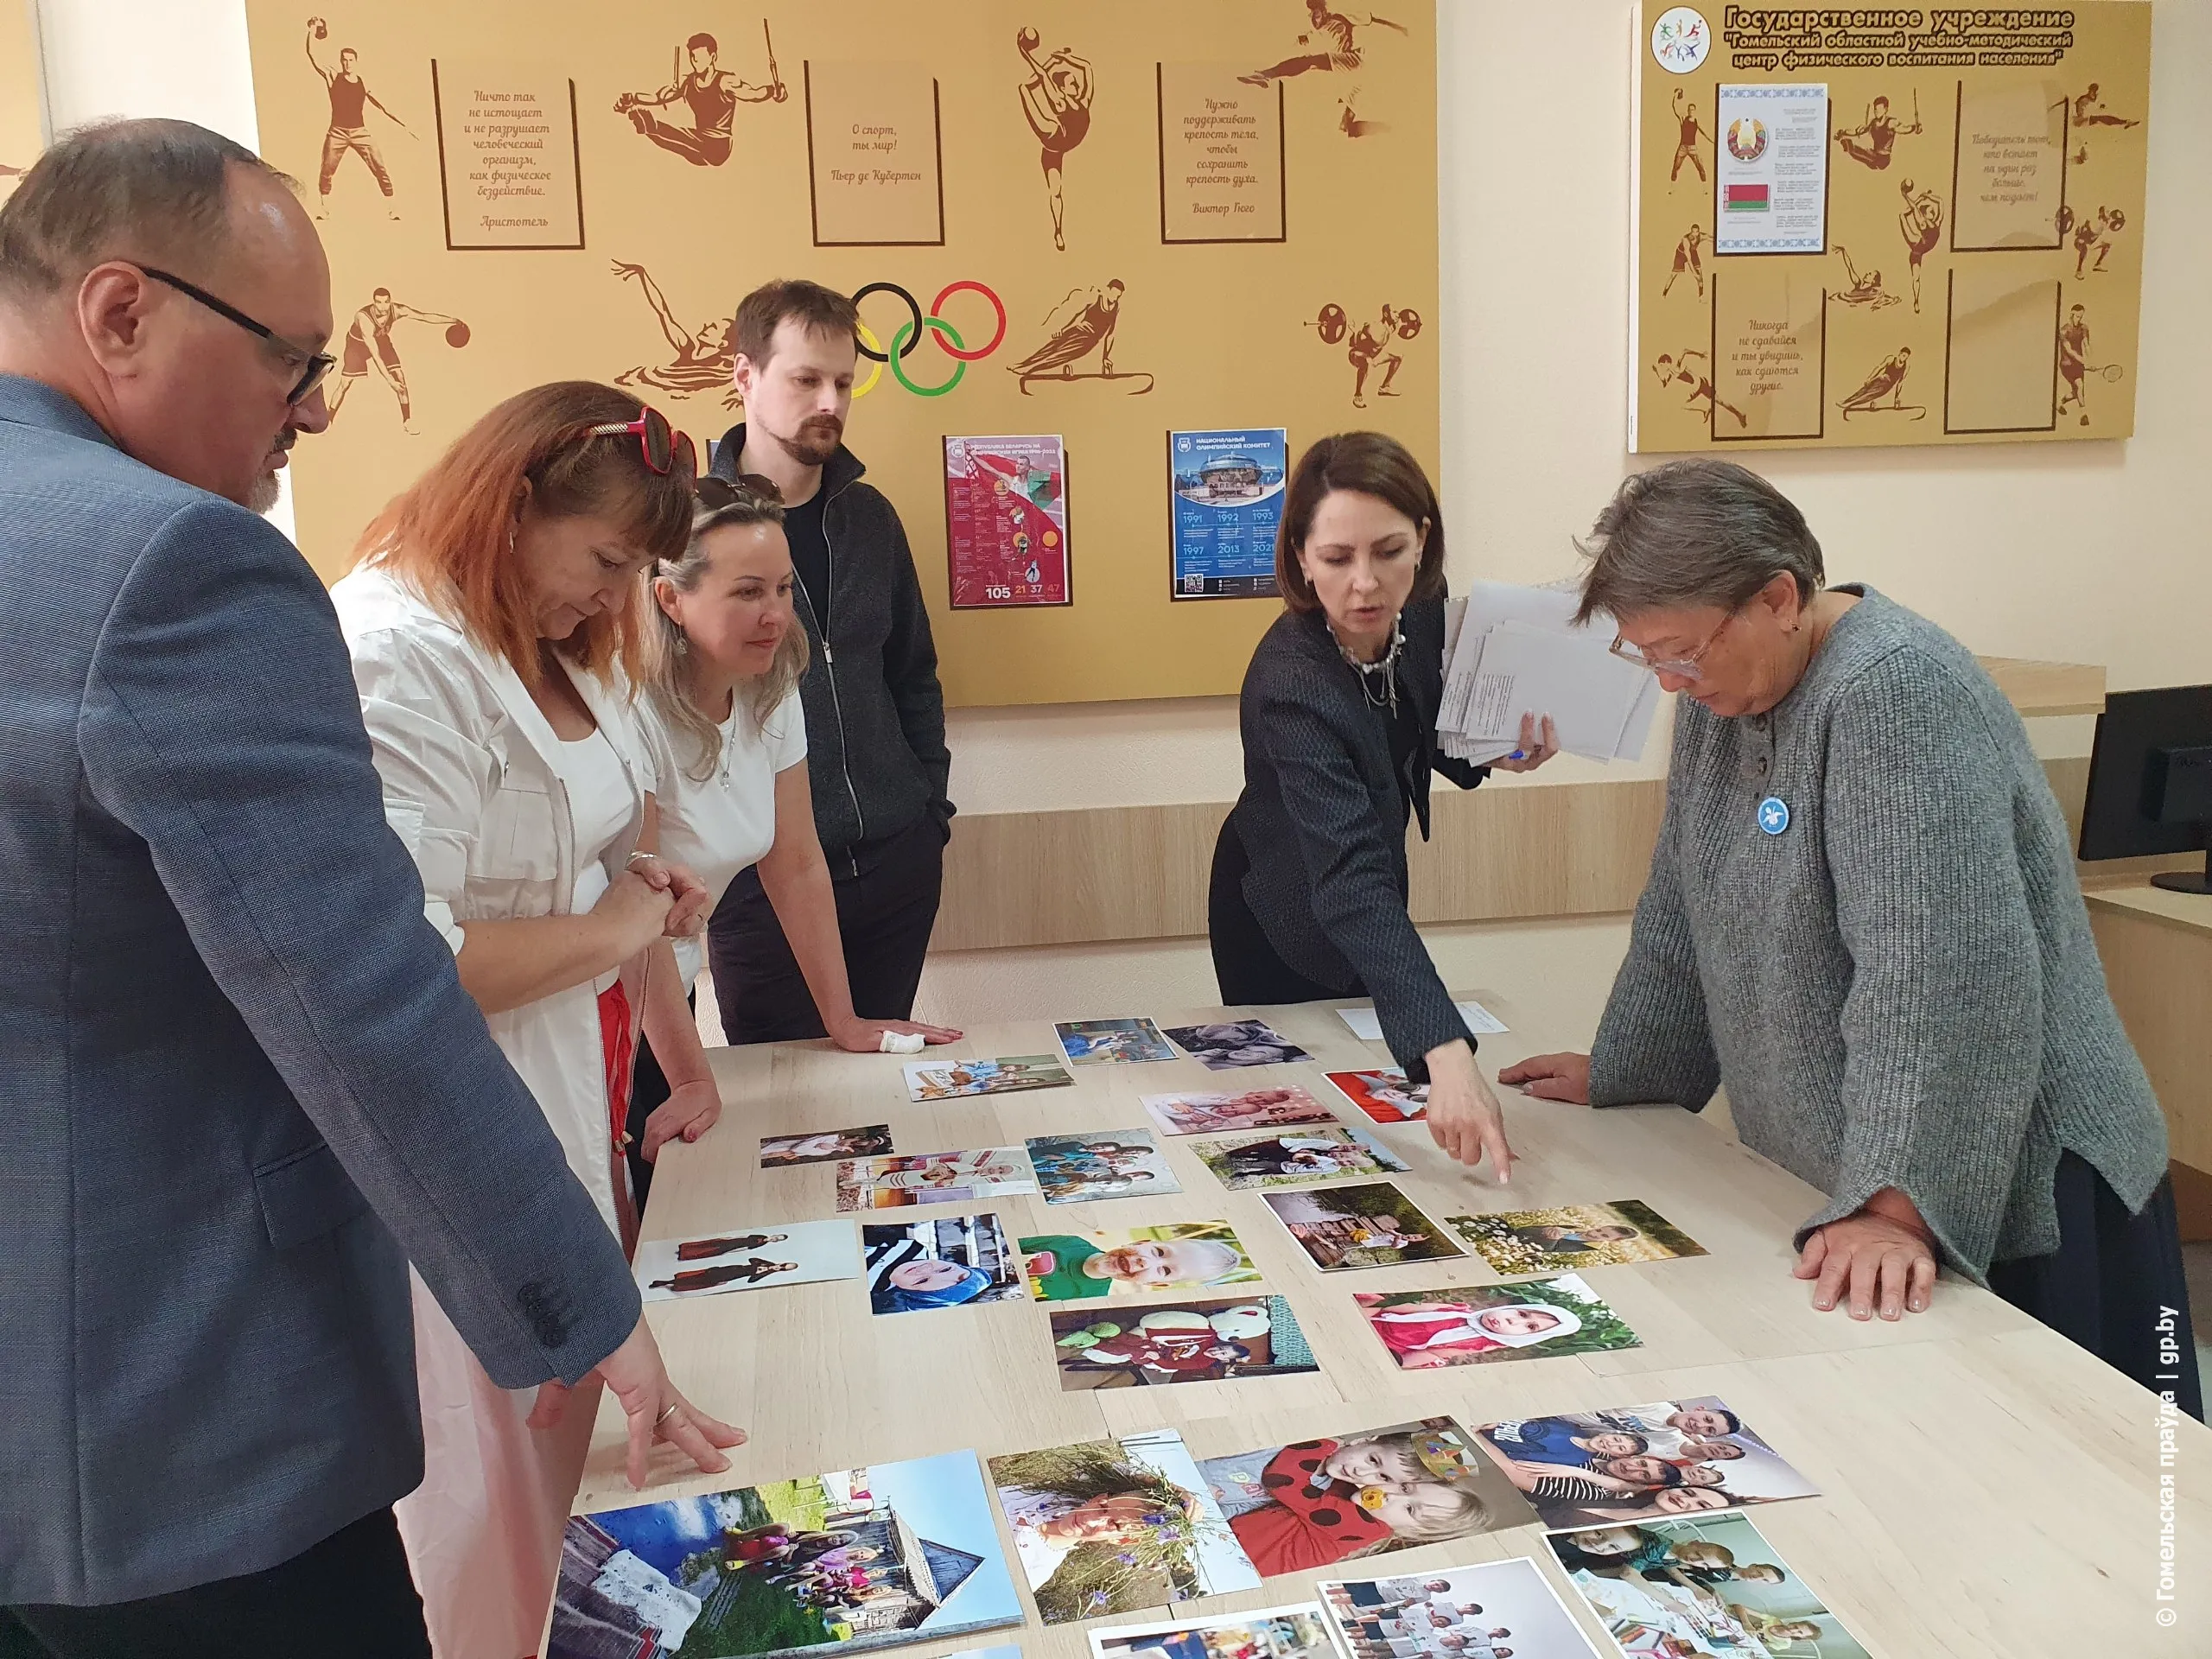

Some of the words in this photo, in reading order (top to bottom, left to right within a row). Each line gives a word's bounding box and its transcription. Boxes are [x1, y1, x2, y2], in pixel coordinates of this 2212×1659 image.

[1726, 5, 1923, 33] Государственное
[1930, 10, 2075, 33] учреждение
[1724, 31, 1822, 49] "Гомельский
[1825, 30, 1905, 48] областной
[1909, 30, 2073, 51] учебно-методический
[1732, 53, 1779, 70] центр
[1782, 50, 1885, 71] физического
[1887, 51, 1975, 67] воспитания
[1979, 48, 2064, 66] населения"
[474, 90, 511, 103] Ничто
[513, 92, 536, 102] так
[1205, 98, 1238, 113] Нужно
[469, 109, 480, 118] не
[484, 109, 543, 119] истощает
[1184, 114, 1255, 129] поддерживать
[488, 124, 550, 137] разрушает
[852, 124, 860, 135] О
[862, 126, 897, 139] спорт,
[474, 139, 543, 149] человеческий
[1184, 132, 1228, 143] крепость
[852, 142, 869, 150] ты
[872, 139, 898, 155] мир!
[1206, 144, 1237, 154] чтобы
[483, 156, 537, 168] организм,
[1197, 160, 1248, 173] сохранить
[491, 171, 551, 184] физическое
[831, 169, 855, 185] Пьер
[858, 173, 869, 185] де
[872, 169, 921, 185] Кубертен
[1186, 175, 1230, 188] крепость
[477, 185, 546, 200] бездействие.
[1192, 203, 1230, 217] Виктор
[1234, 202, 1255, 213] Гюго
[480, 216, 549, 231] Аристотель
[1749, 320, 1789, 334] Никогда
[1752, 335, 1796, 350] сдавайся
[1755, 366, 1799, 380] сдаются
[1196, 435, 1246, 444] НАЦИОНАЛЬНЫЙ
[1183, 514, 1203, 524] 1991
[1217, 513, 1239, 523] 1992
[1252, 512, 1274, 520] 1993
[1183, 546, 1204, 556] 1997
[1217, 545, 1240, 554] 2013
[1252, 543, 1274, 552] 2021
[985, 587, 1011, 599] 105
[1015, 585, 1027, 594] 21
[1030, 584, 1043, 594] 37
[1047, 583, 1060, 593] 47
